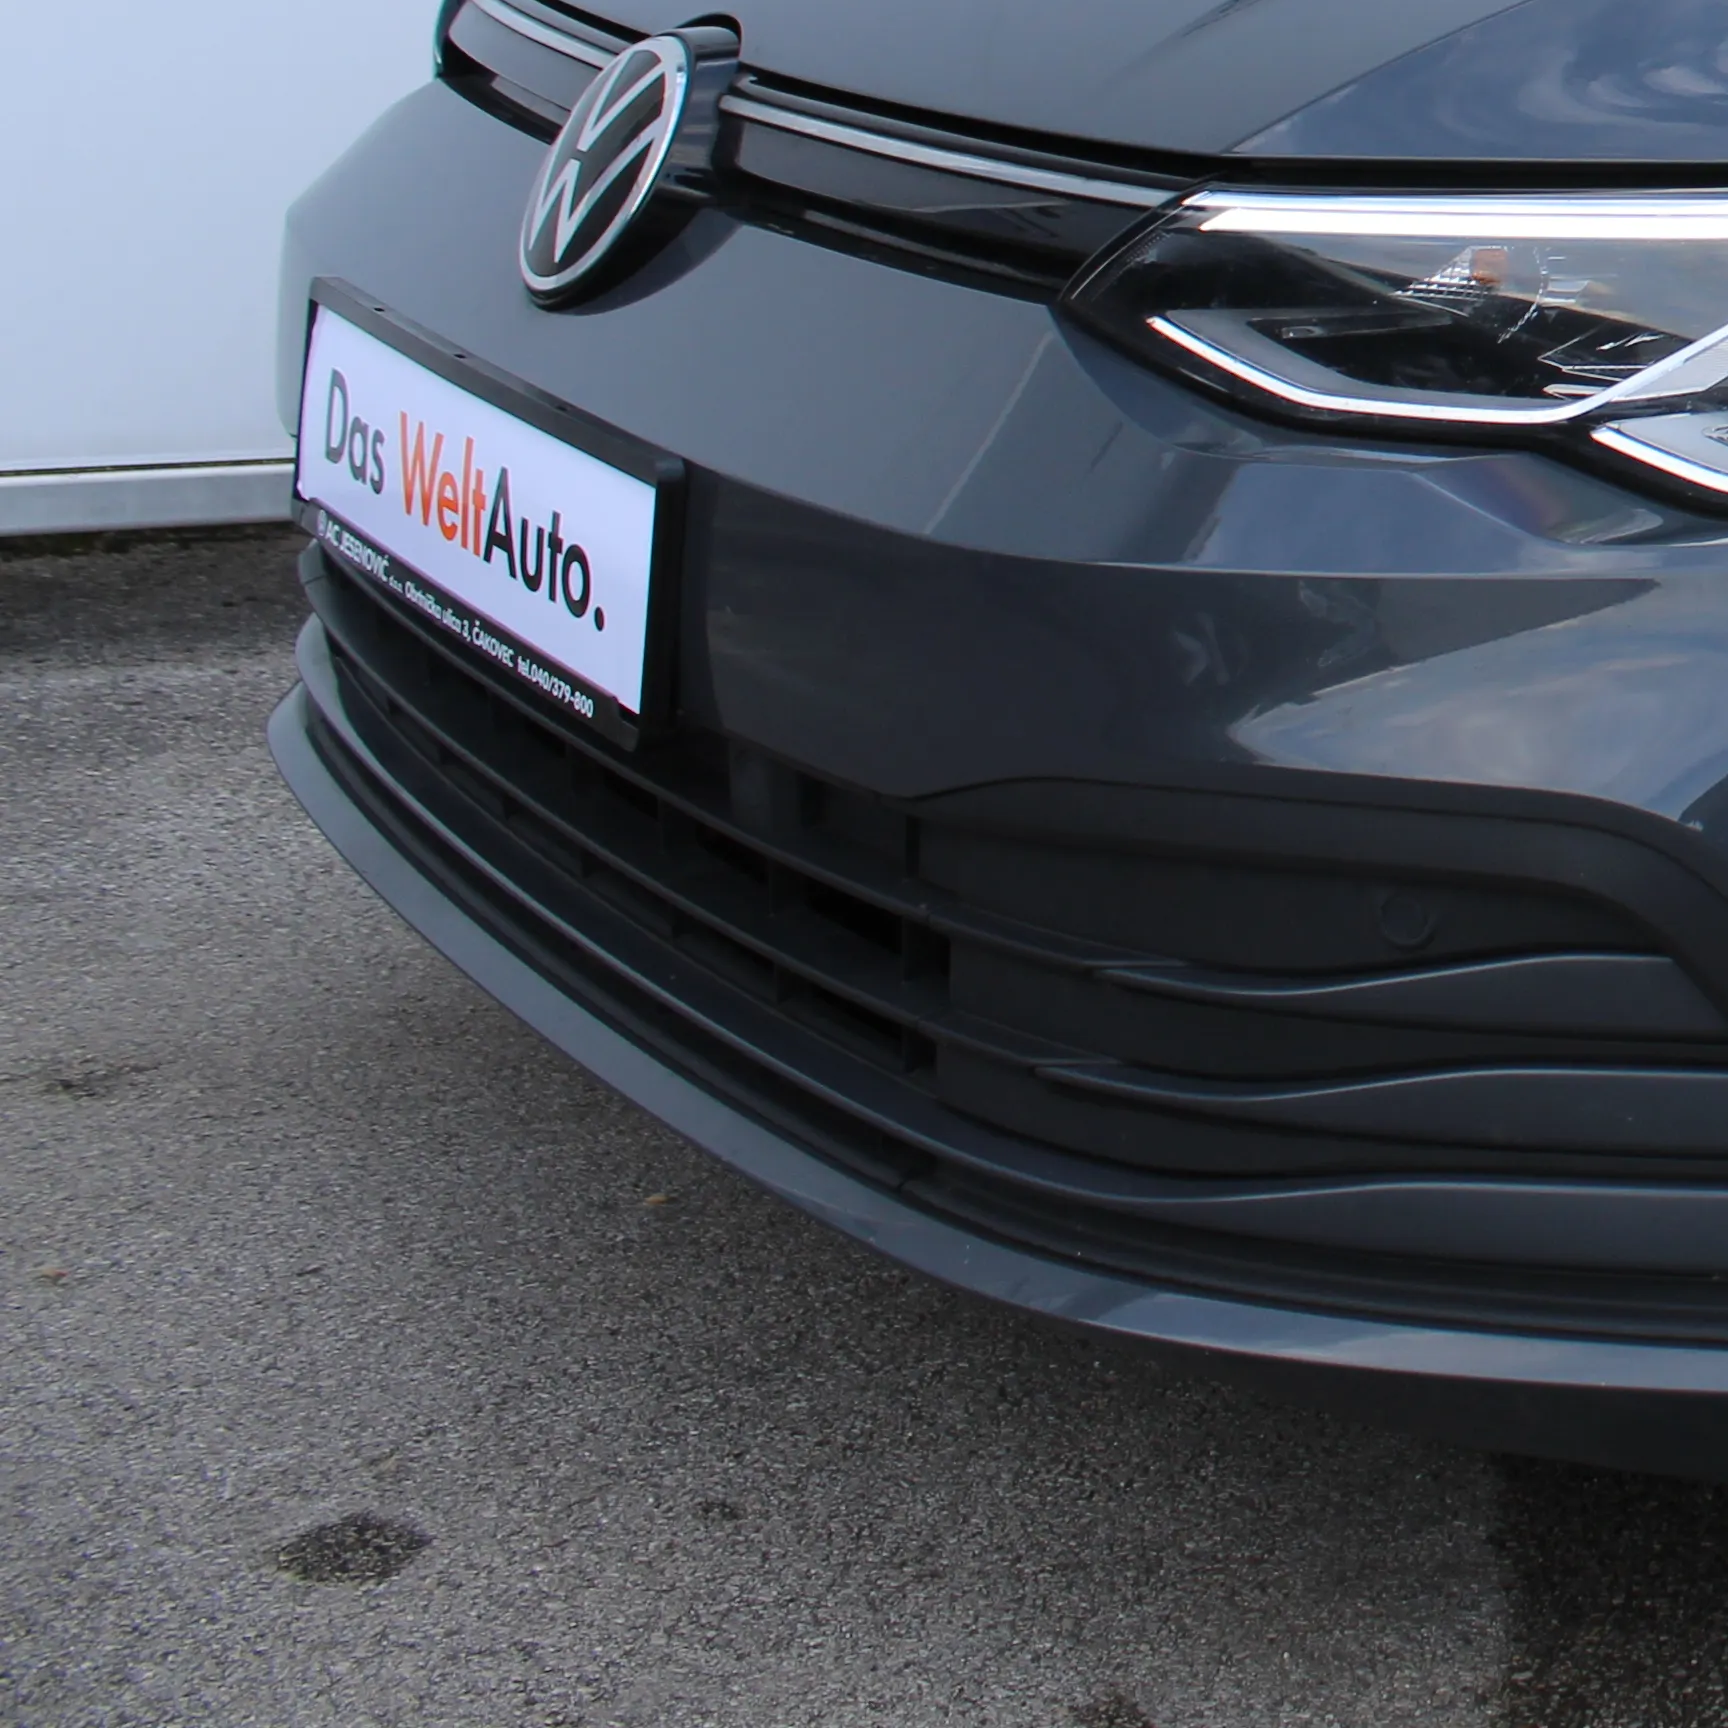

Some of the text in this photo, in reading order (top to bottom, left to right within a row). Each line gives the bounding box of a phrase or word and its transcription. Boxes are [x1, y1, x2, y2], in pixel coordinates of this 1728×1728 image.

[324, 367, 386, 495] Das
[325, 520, 341, 547] AC
[340, 530, 389, 583] JESENOVIĆ
[472, 619, 514, 668] ČAKOVEC
